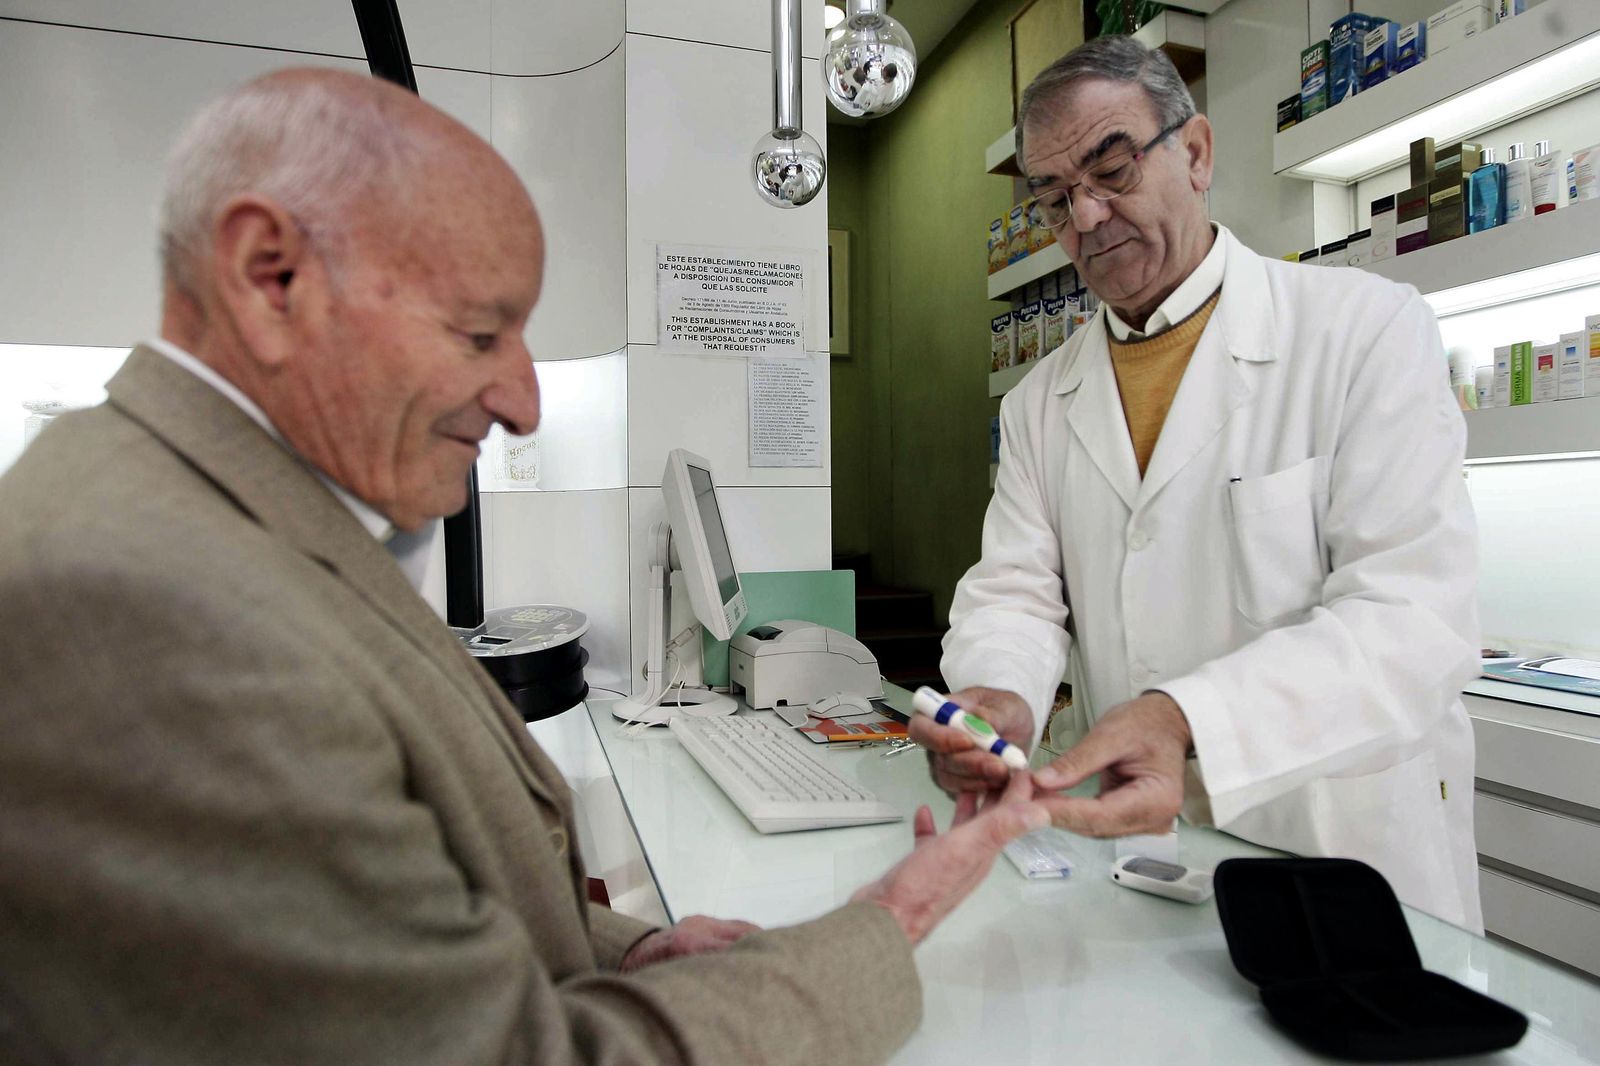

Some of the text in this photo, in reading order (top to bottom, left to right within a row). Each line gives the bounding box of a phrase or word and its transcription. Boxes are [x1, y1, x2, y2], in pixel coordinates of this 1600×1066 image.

[688, 257, 755, 267] ESTABLECIMIENTO
[681, 274, 728, 282] DISPOSICION
[746, 278, 793, 286] CONSUMIDOR
[690, 317, 750, 326] ESTABLISHMENT
[684, 326, 767, 335] "COMPLAINTS/CLAIMS"
